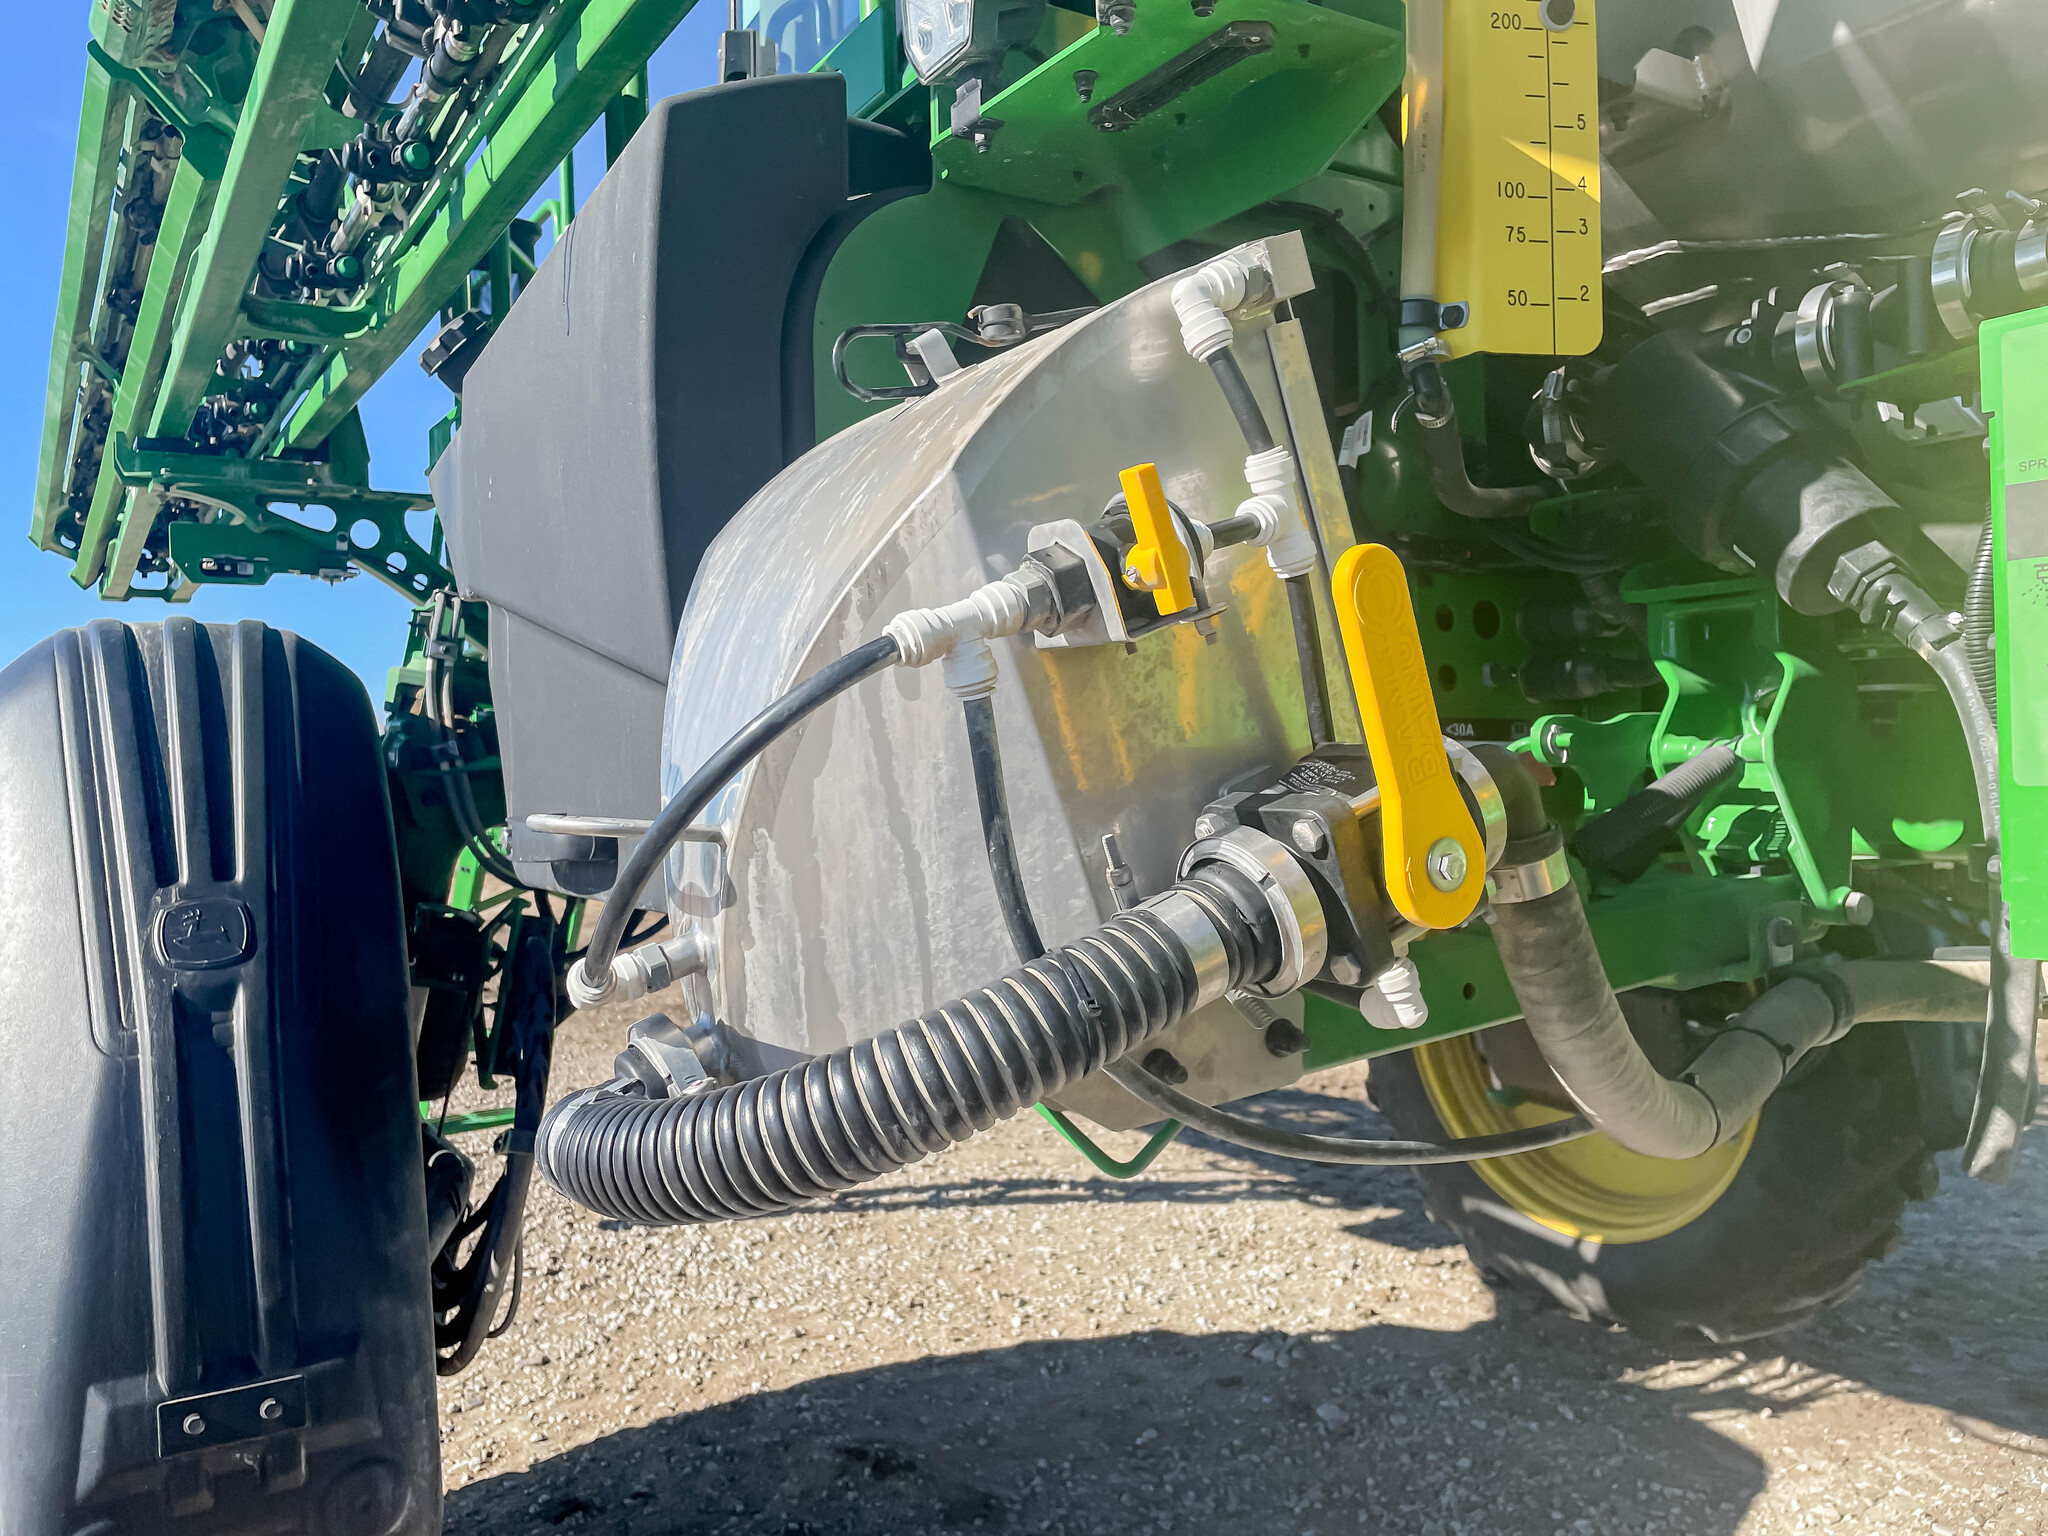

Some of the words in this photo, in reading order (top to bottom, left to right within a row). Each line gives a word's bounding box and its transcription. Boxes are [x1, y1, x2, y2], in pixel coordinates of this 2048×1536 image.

[1490, 12, 1521, 30] 200
[1577, 114, 1586, 130] 5
[1498, 181, 1525, 198] 100
[1578, 176, 1587, 193] 4
[1506, 226, 1526, 242] 75
[1579, 218, 1588, 235] 3
[1507, 290, 1528, 306] 50
[1580, 286, 1589, 301] 2
[2019, 458, 2048, 472] SPR
